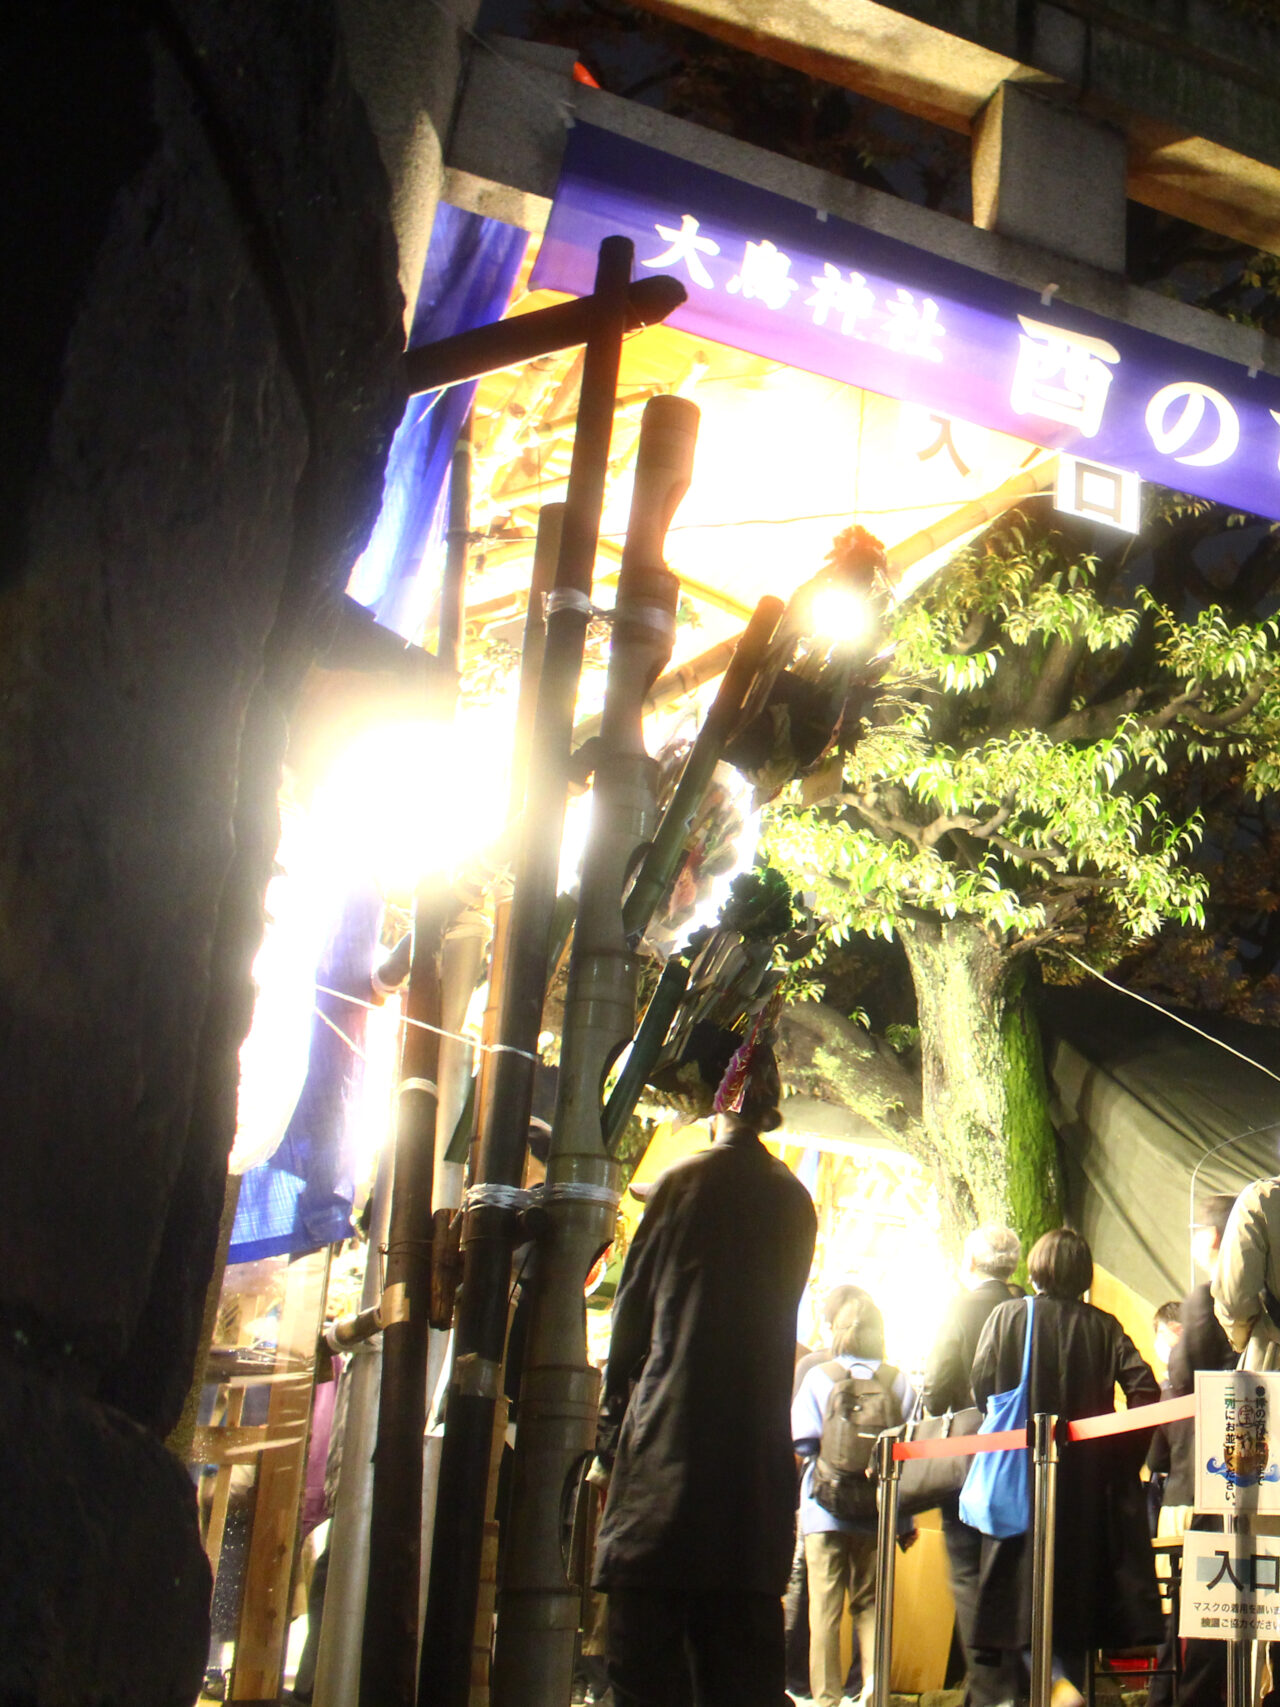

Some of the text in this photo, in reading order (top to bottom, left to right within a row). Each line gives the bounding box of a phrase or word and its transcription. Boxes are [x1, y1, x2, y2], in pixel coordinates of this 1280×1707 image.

[1223, 1386, 1236, 1506] 二列にお並びください。
[1206, 1550, 1280, 1594] 入口
